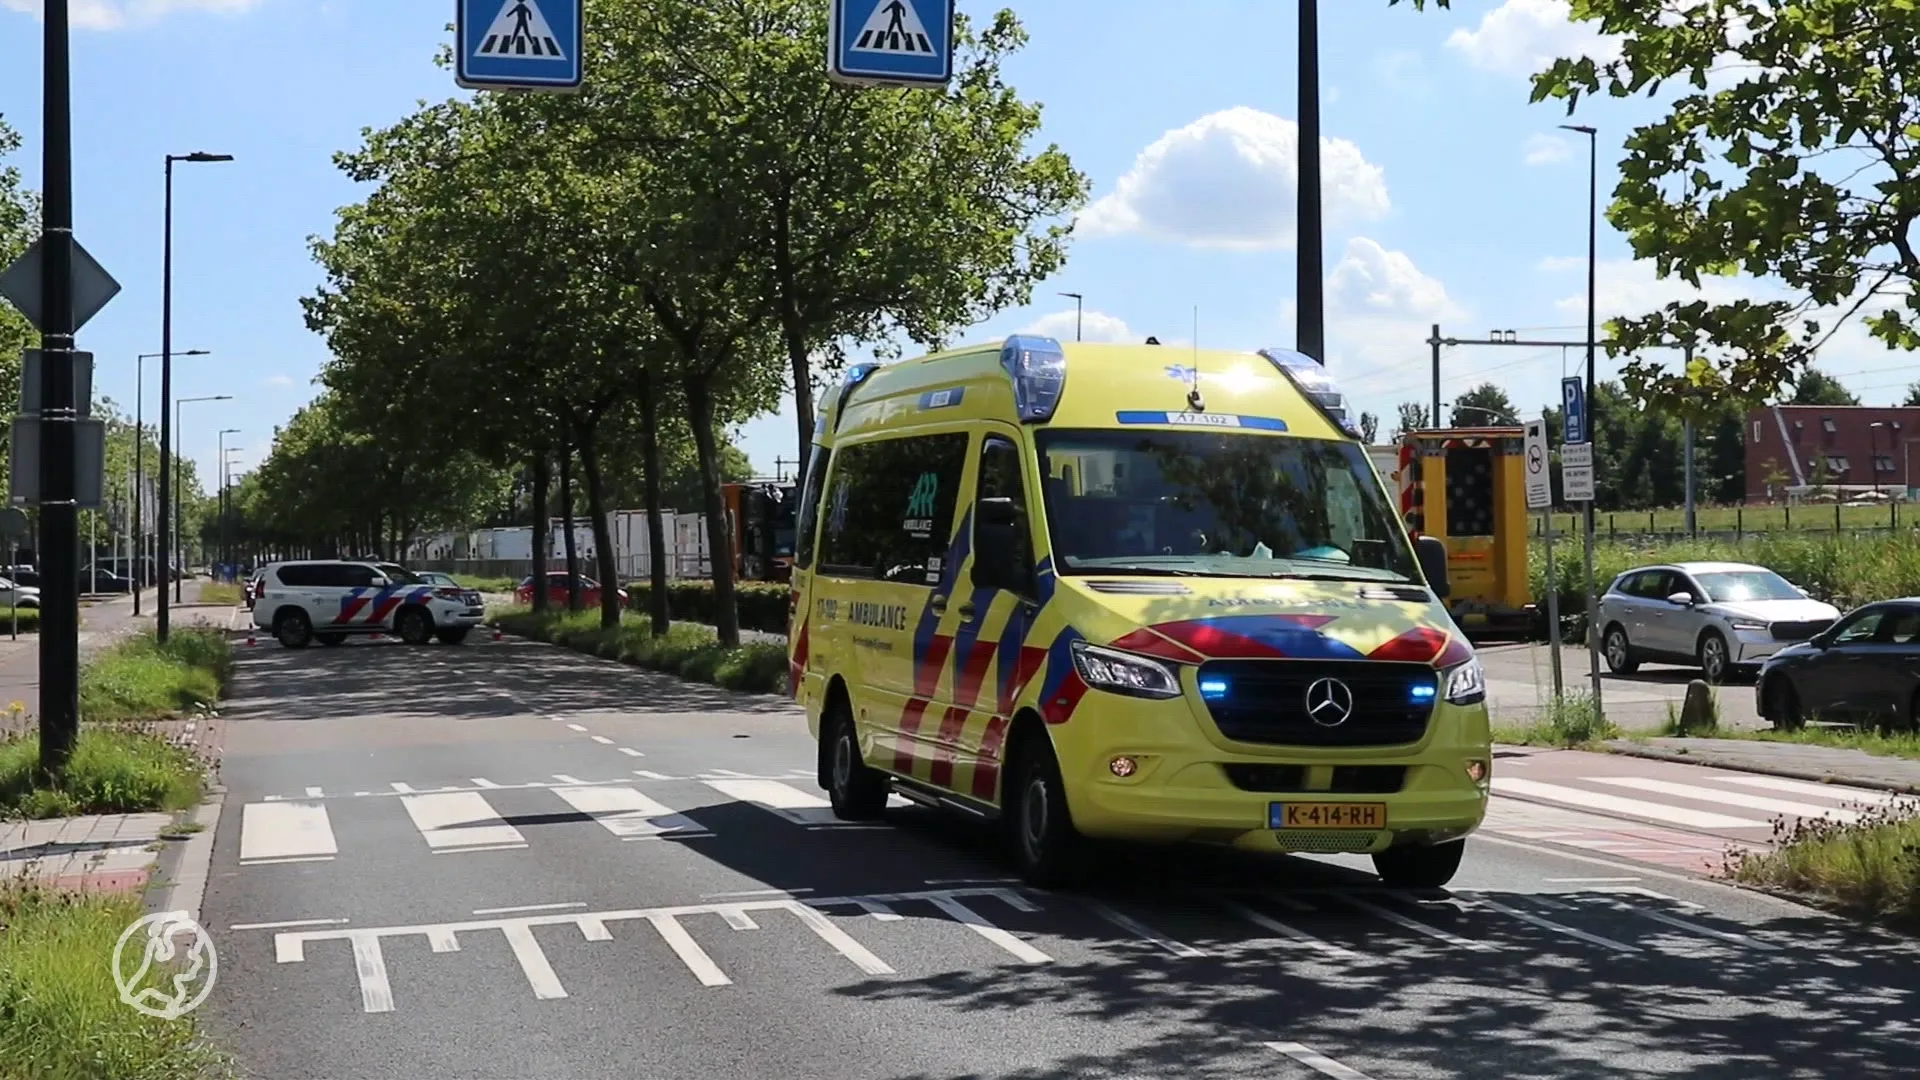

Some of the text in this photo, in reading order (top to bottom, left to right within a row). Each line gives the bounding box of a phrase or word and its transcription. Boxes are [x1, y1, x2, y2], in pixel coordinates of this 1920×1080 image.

[1566, 383, 1576, 415] P
[849, 601, 907, 631] AMBULANCE
[1287, 806, 1376, 825] K-414-RH
